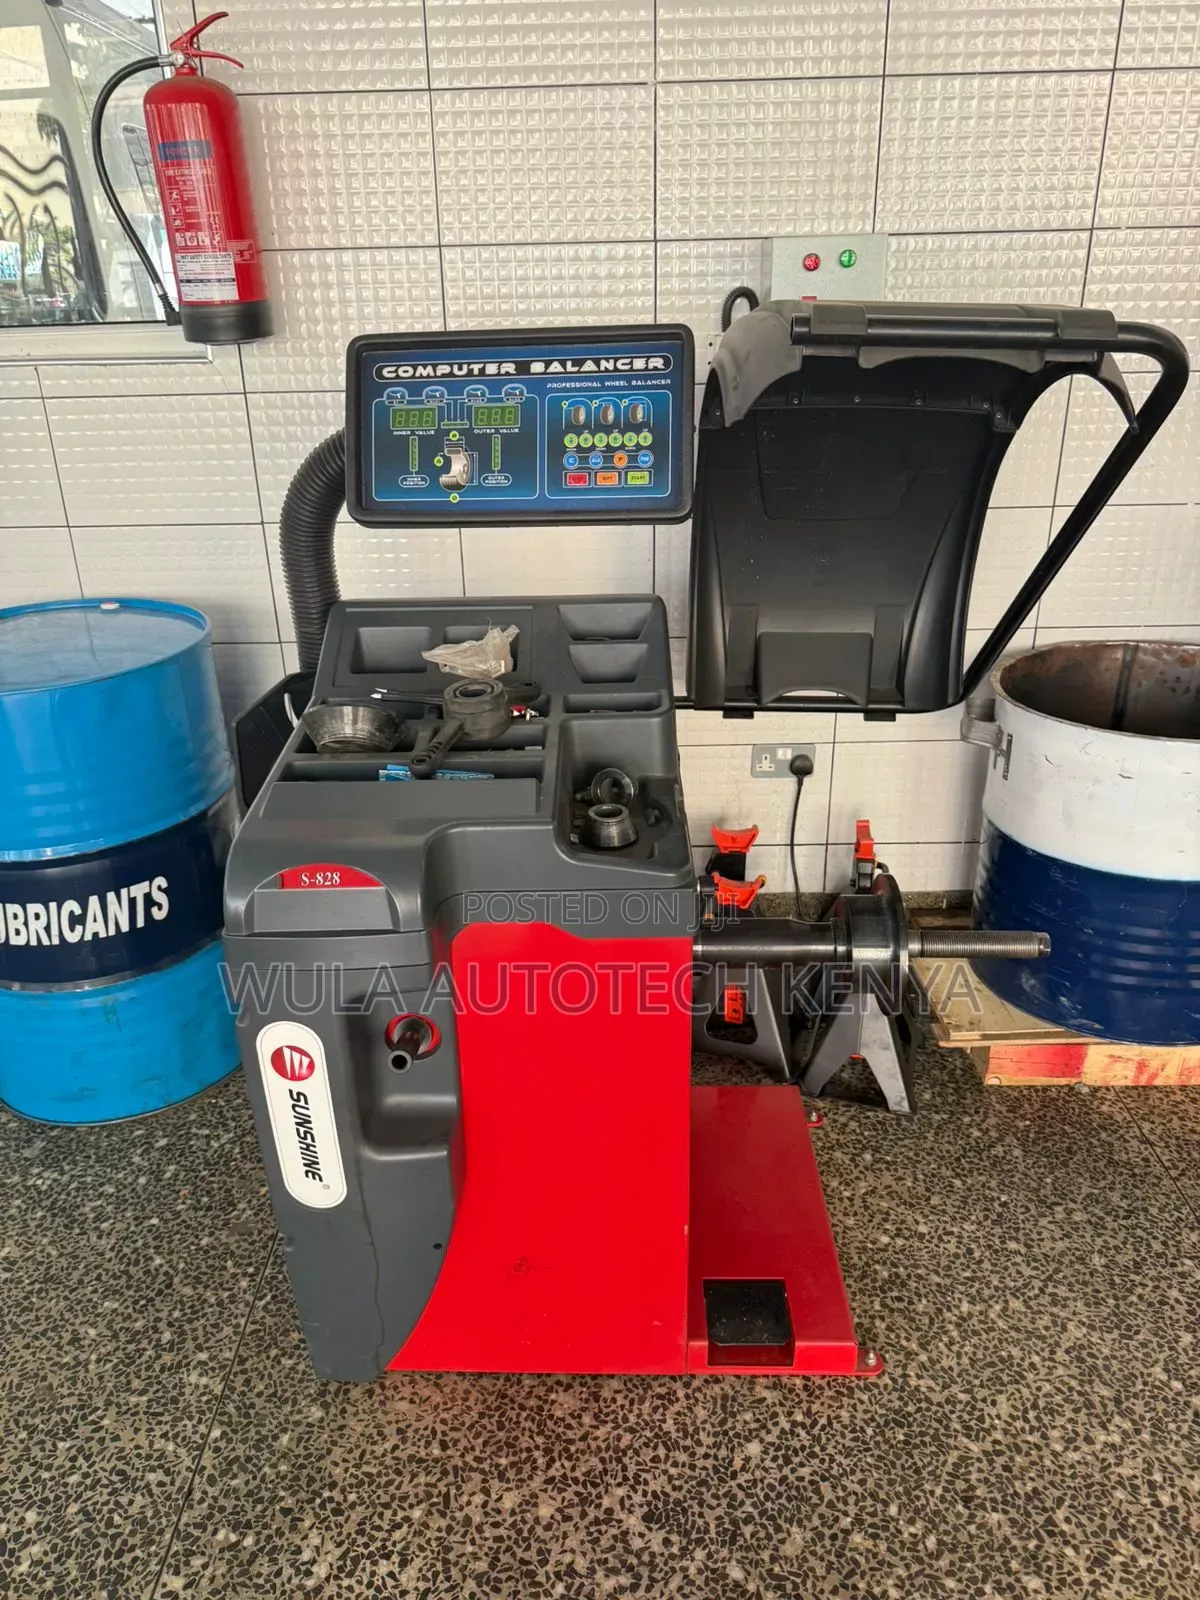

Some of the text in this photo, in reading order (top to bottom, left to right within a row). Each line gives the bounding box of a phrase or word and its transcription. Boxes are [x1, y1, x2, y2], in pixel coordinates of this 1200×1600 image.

[382, 358, 665, 378] COMPUTER BALANCER
[300, 871, 341, 887] S-828
[288, 1088, 324, 1183] SUNSHINE
